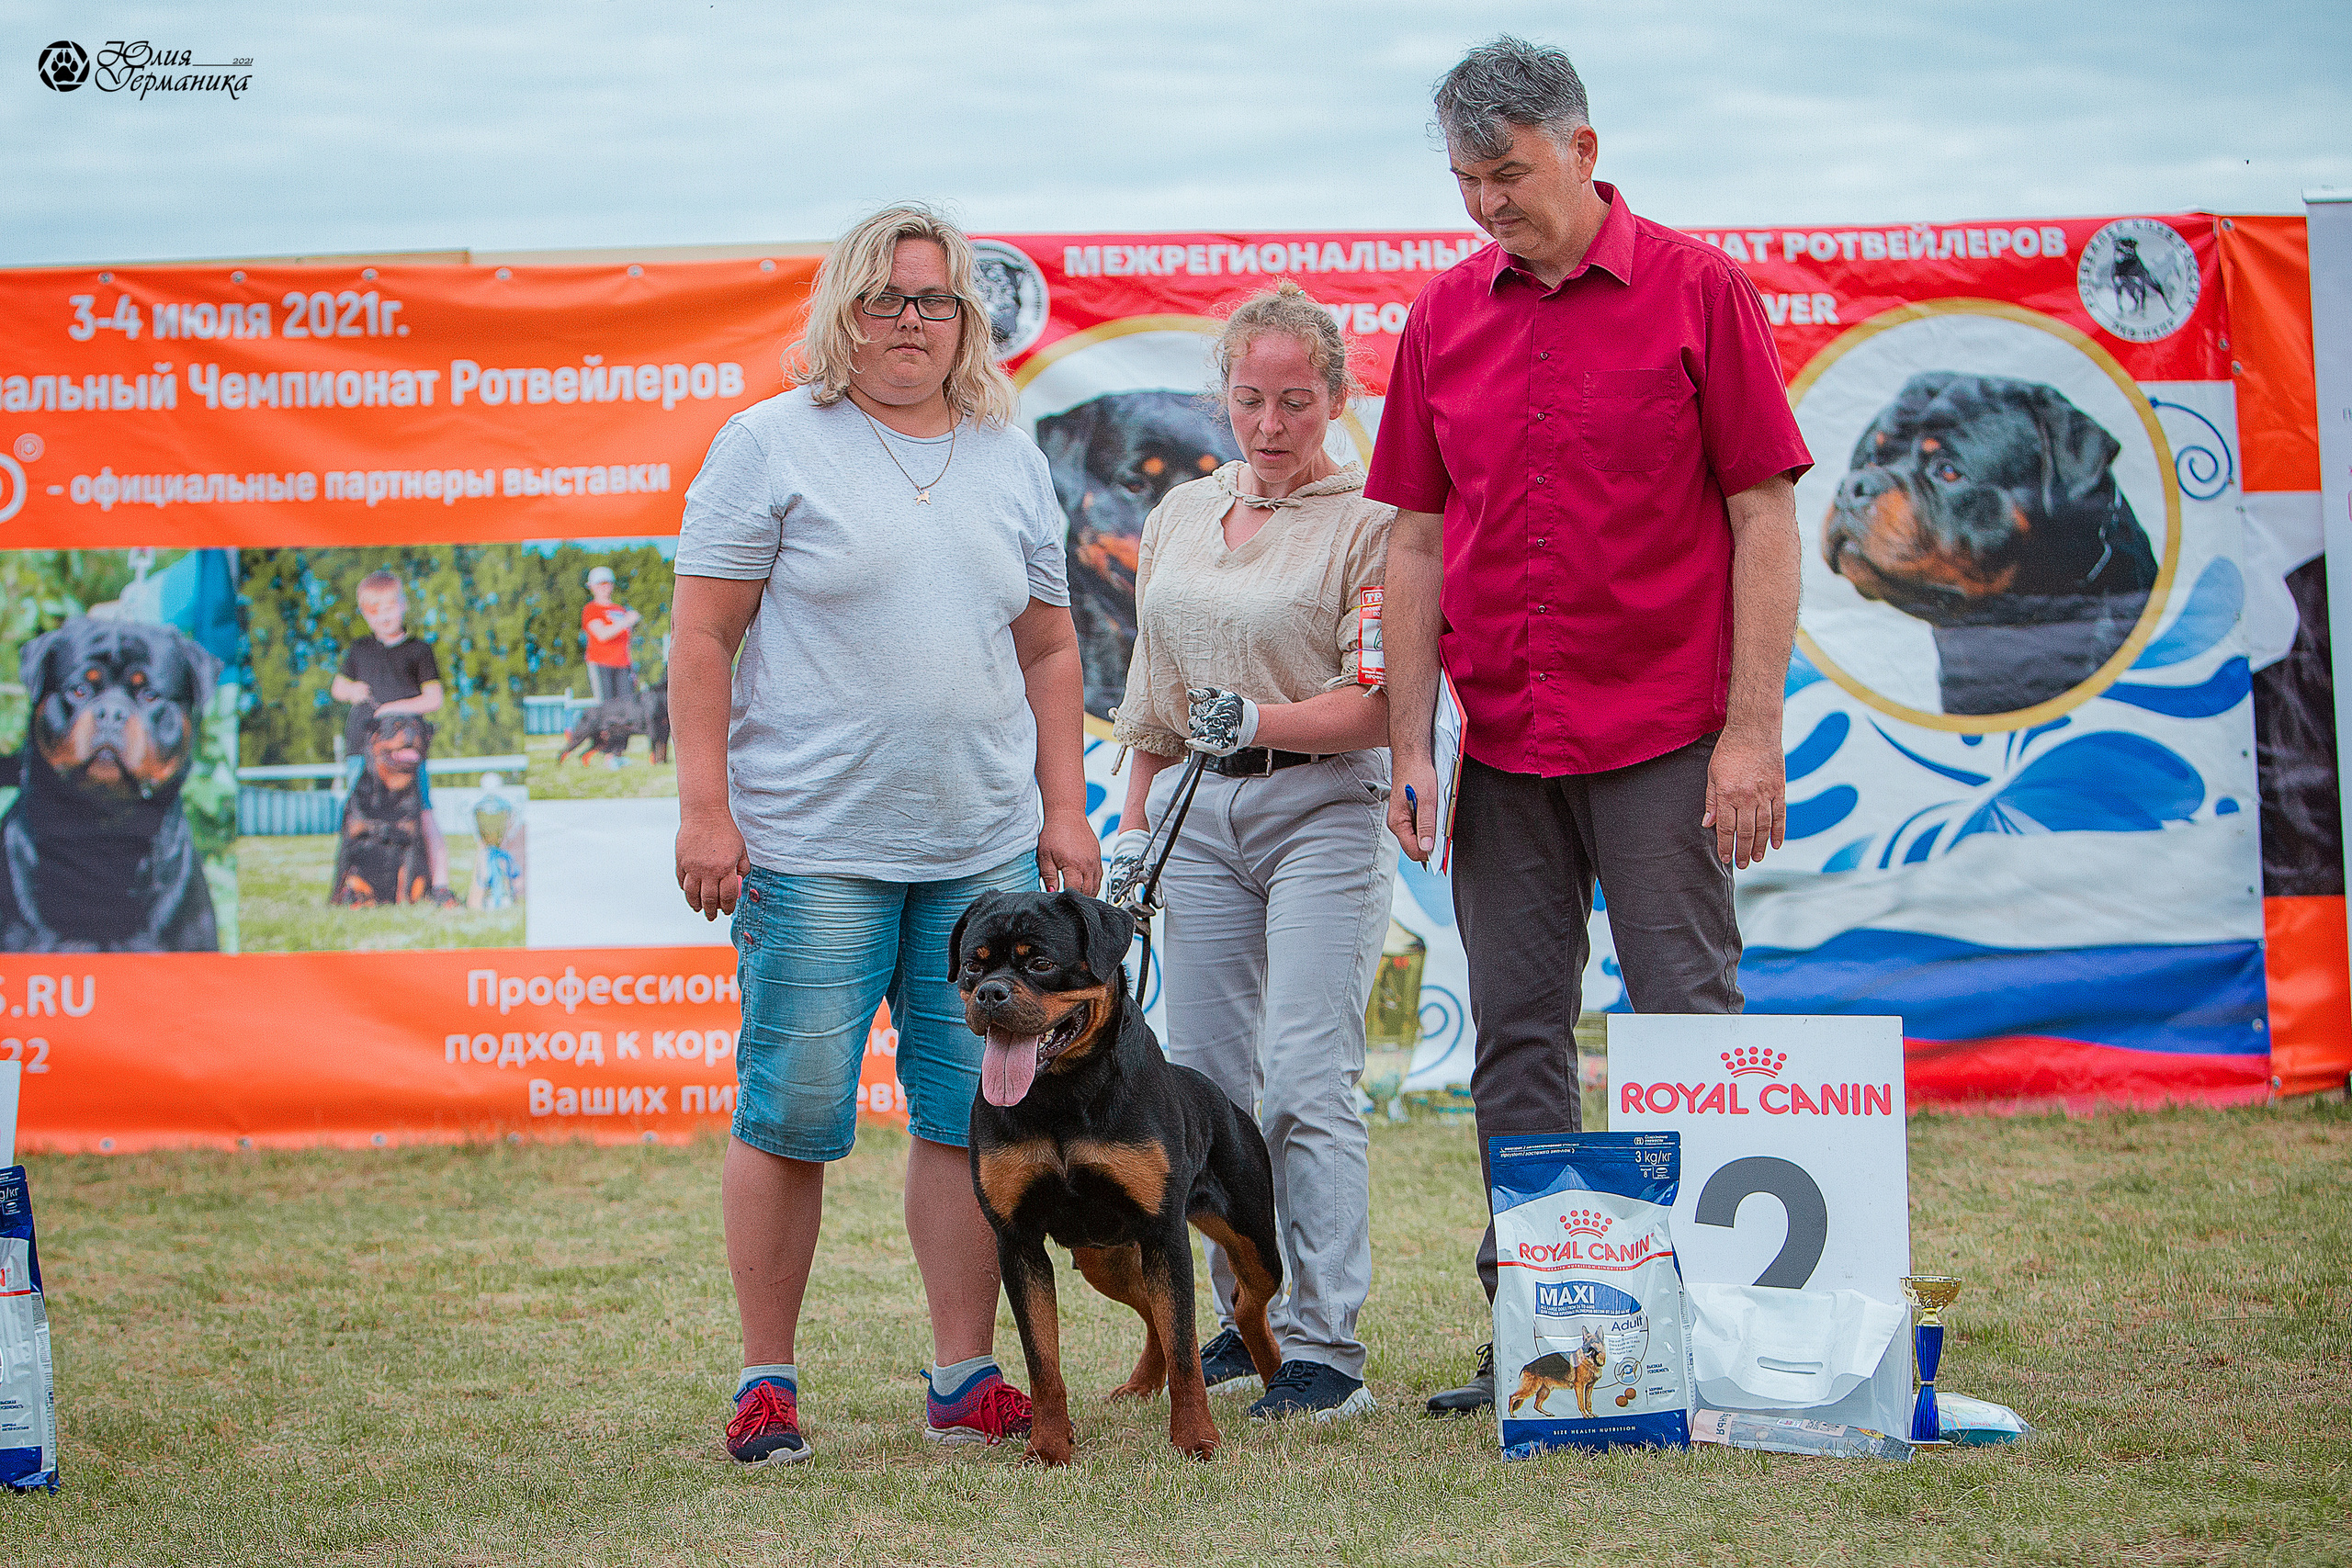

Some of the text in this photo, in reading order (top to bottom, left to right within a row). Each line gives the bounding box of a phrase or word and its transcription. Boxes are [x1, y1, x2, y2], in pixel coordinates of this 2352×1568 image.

[1781, 224, 2068, 264] РОТВЕЙЛЕРОВ
[68, 290, 411, 341] 3-4 июля 2021г.
[1324, 301, 1414, 335] УБО
[0, 355, 746, 412] альный Чемпионат Ротвейлеров
[70, 467, 318, 512] официальные
[324, 468, 495, 507] партнеры
[503, 463, 671, 498] выставки
[1365, 592, 1384, 604] ТР
[0, 975, 96, 1018] .RU
[467, 965, 741, 1015] Профессион
[445, 1030, 605, 1069] подход
[616, 1031, 640, 1059] к
[528, 1078, 668, 1117] Ваших
[681, 1085, 741, 1113] пи
[1621, 1082, 1892, 1115] ROYAL CANIN
[1634, 1150, 1672, 1165] 3 kg/кг
[1695, 1156, 1827, 1289] 2
[1519, 1235, 1650, 1262] ROYAL CANIN
[1539, 1285, 1595, 1306] MAXI
[1611, 1314, 1644, 1332] Adult
